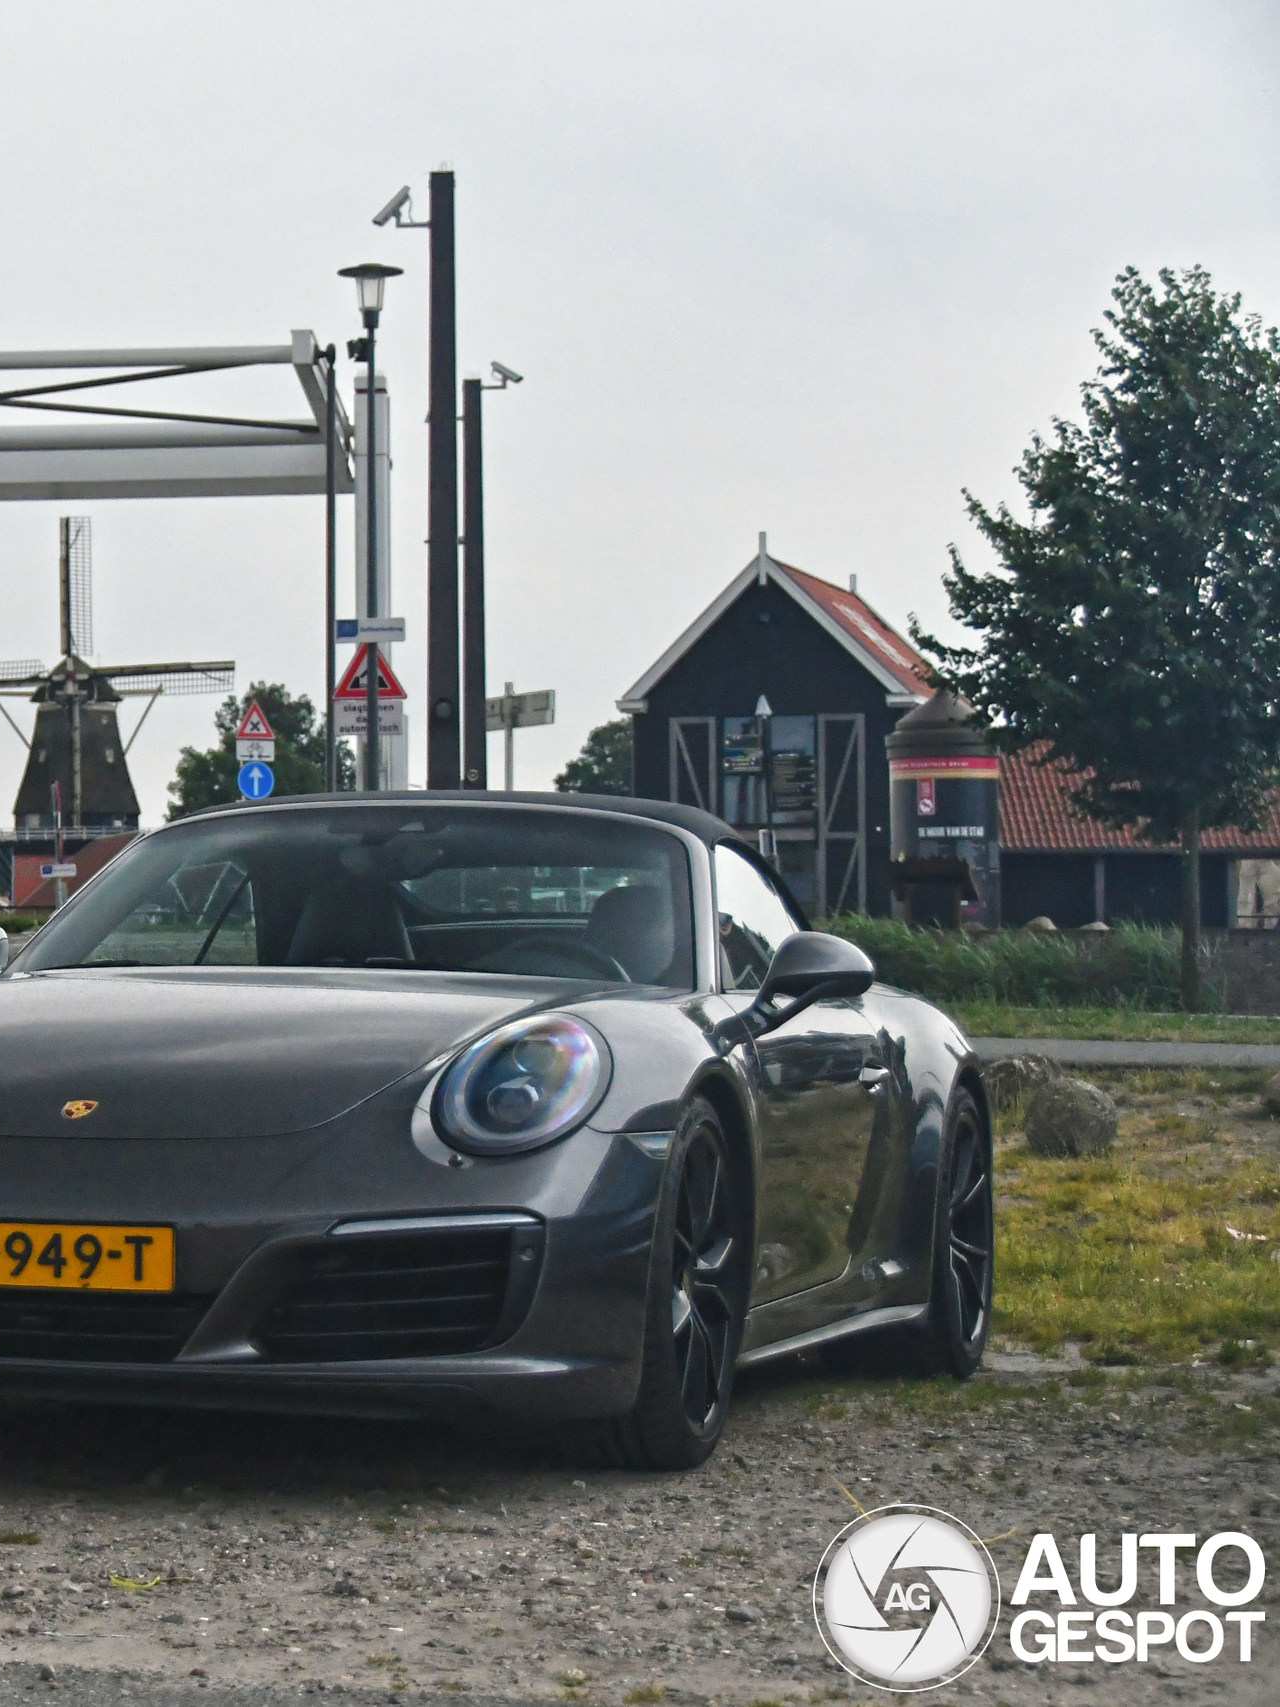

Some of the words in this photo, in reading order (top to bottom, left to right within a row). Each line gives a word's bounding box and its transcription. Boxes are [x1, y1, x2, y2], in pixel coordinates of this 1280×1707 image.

[343, 704, 394, 713] slagben
[356, 715, 382, 723] dan
[339, 724, 399, 732] automisch
